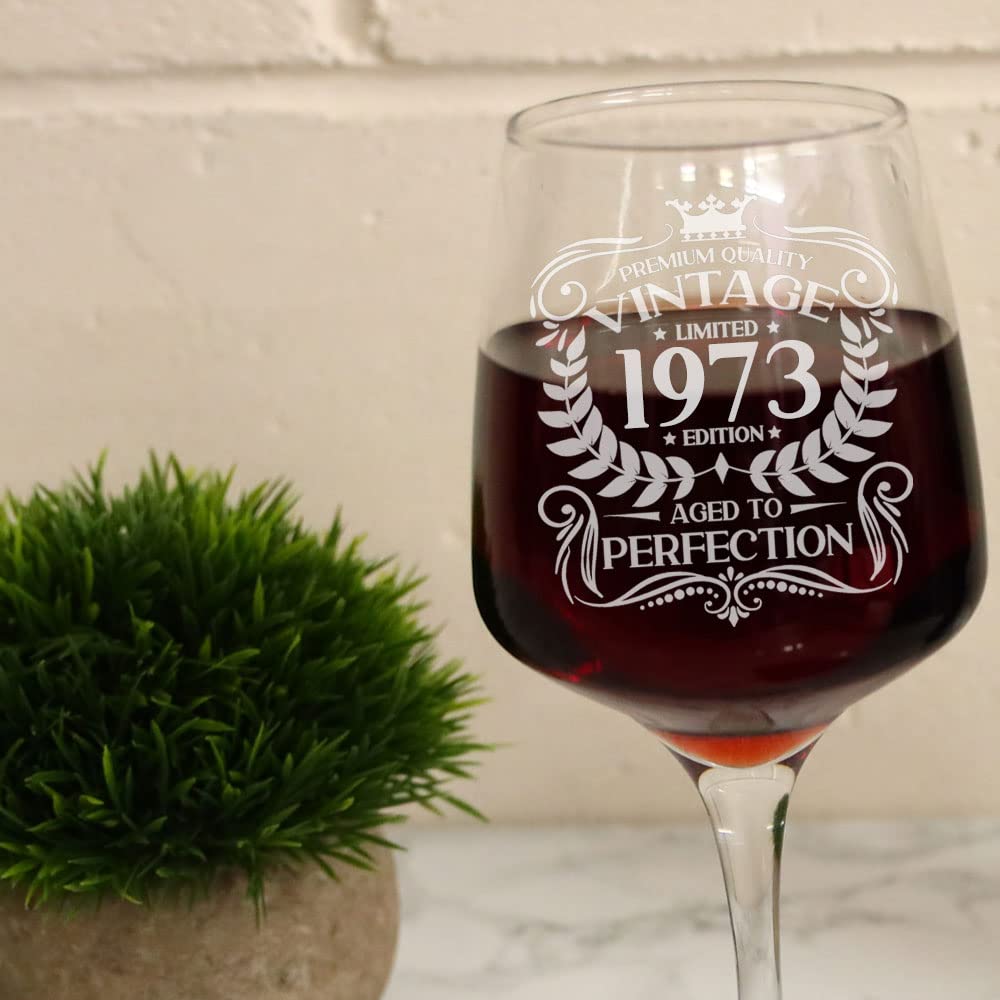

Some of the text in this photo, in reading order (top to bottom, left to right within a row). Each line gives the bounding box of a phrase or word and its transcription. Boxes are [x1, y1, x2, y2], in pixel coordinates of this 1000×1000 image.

[618, 246, 814, 282] PREMIUM QUALITY
[583, 269, 840, 334] VINTAGE
[675, 320, 759, 341] LIMITED
[615, 339, 822, 430] 1973
[682, 425, 765, 447] EDITION
[670, 497, 783, 525] AGED TO
[601, 522, 854, 570] PERFECTION
